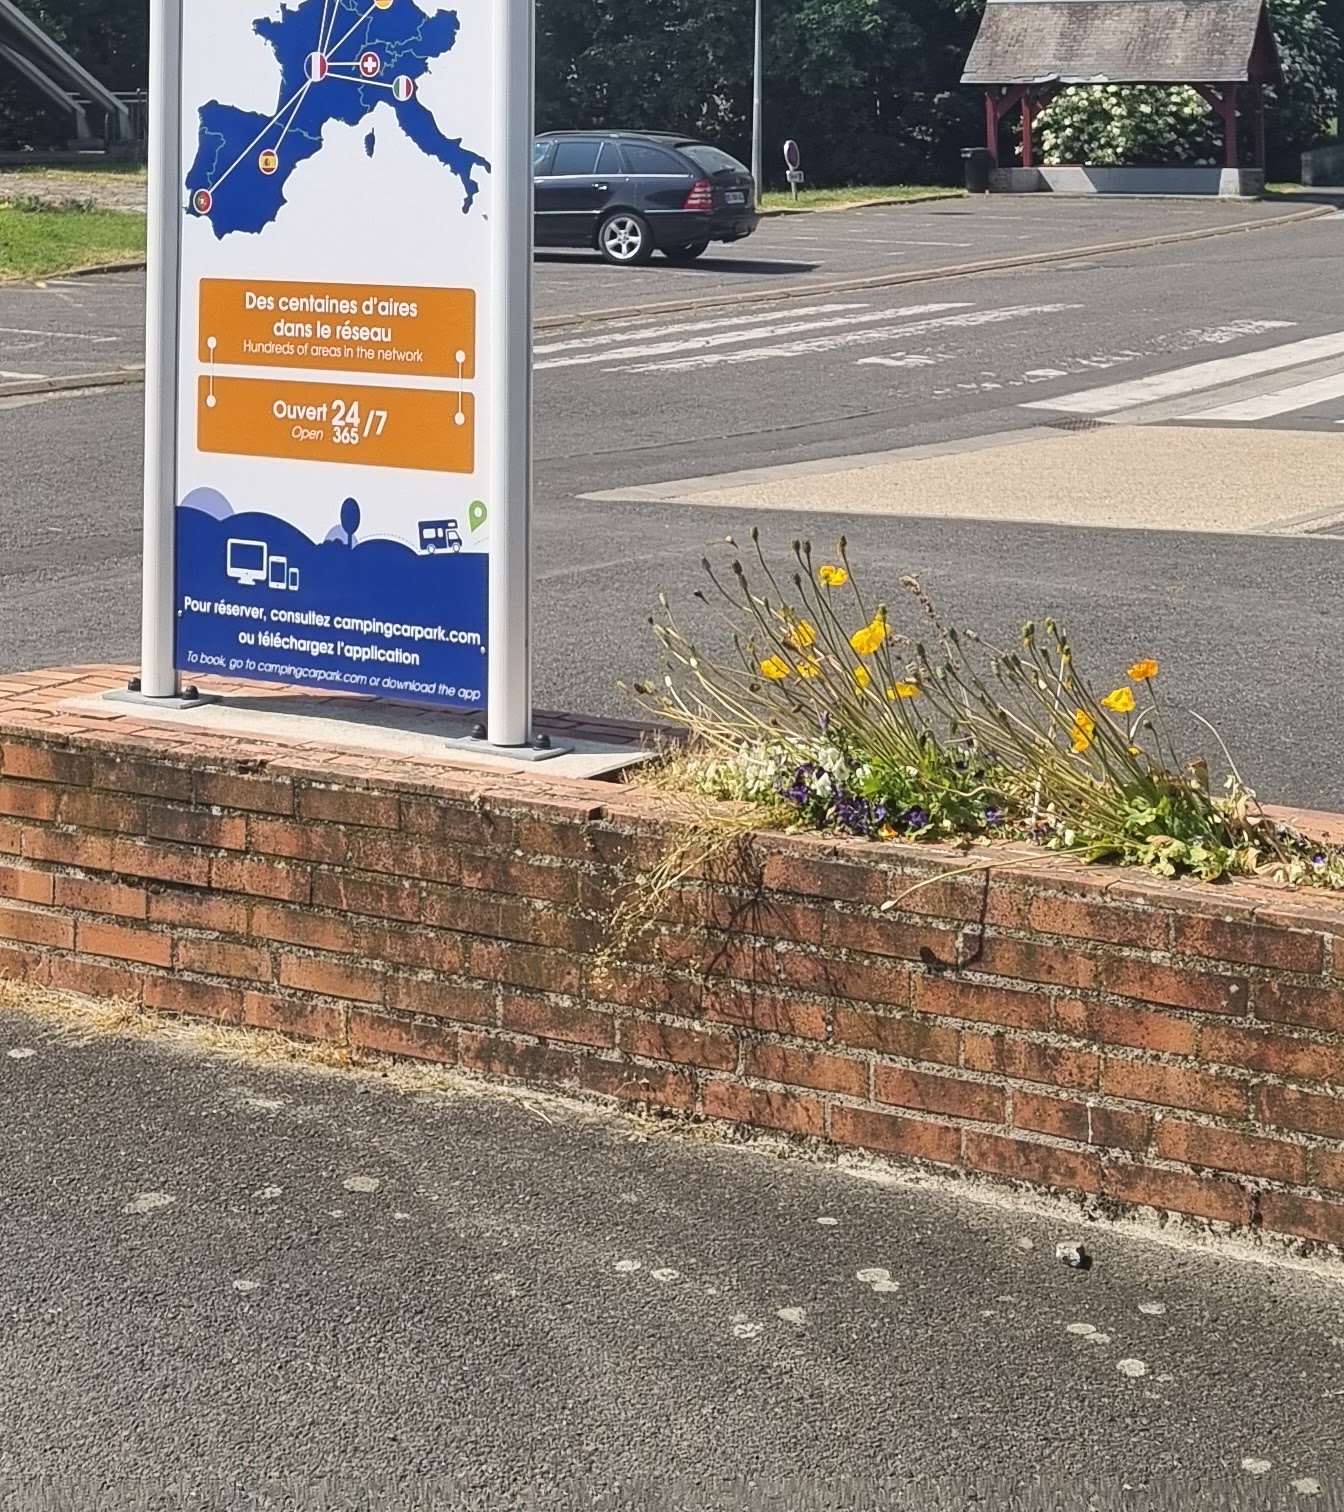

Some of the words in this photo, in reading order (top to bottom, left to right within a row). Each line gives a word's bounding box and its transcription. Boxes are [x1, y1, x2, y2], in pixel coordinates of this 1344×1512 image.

[245, 291, 274, 311] Des
[278, 294, 358, 315] centaines
[361, 297, 418, 318] d'aires
[273, 319, 312, 339] dans
[316, 321, 332, 340] le
[336, 320, 392, 343] réseau
[243, 339, 295, 356] Hundreds
[297, 342, 309, 356] of
[311, 347, 342, 358] areas
[343, 345, 354, 358] in
[356, 346, 375, 360] the
[377, 348, 424, 363] network
[273, 400, 328, 422] Ouvert
[331, 399, 361, 428] 24
[291, 425, 324, 442] Open
[332, 426, 360, 445] 365
[184, 596, 212, 614] Pour
[214, 599, 267, 622] réserver,
[270, 609, 331, 628] consultez
[333, 616, 481, 646] campingcarpark.com
[238, 632, 255, 644] ou
[258, 630, 335, 658] téléchargez
[337, 642, 420, 666] l'application
[187, 650, 199, 663] To
[199, 652, 226, 669] book,
[229, 657, 244, 672] go
[245, 659, 256, 672] to
[258, 660, 367, 687] campingcarpark.com
[369, 676, 381, 688] or
[382, 676, 436, 695] download
[437, 683, 456, 698] the
[457, 687, 481, 702] app
